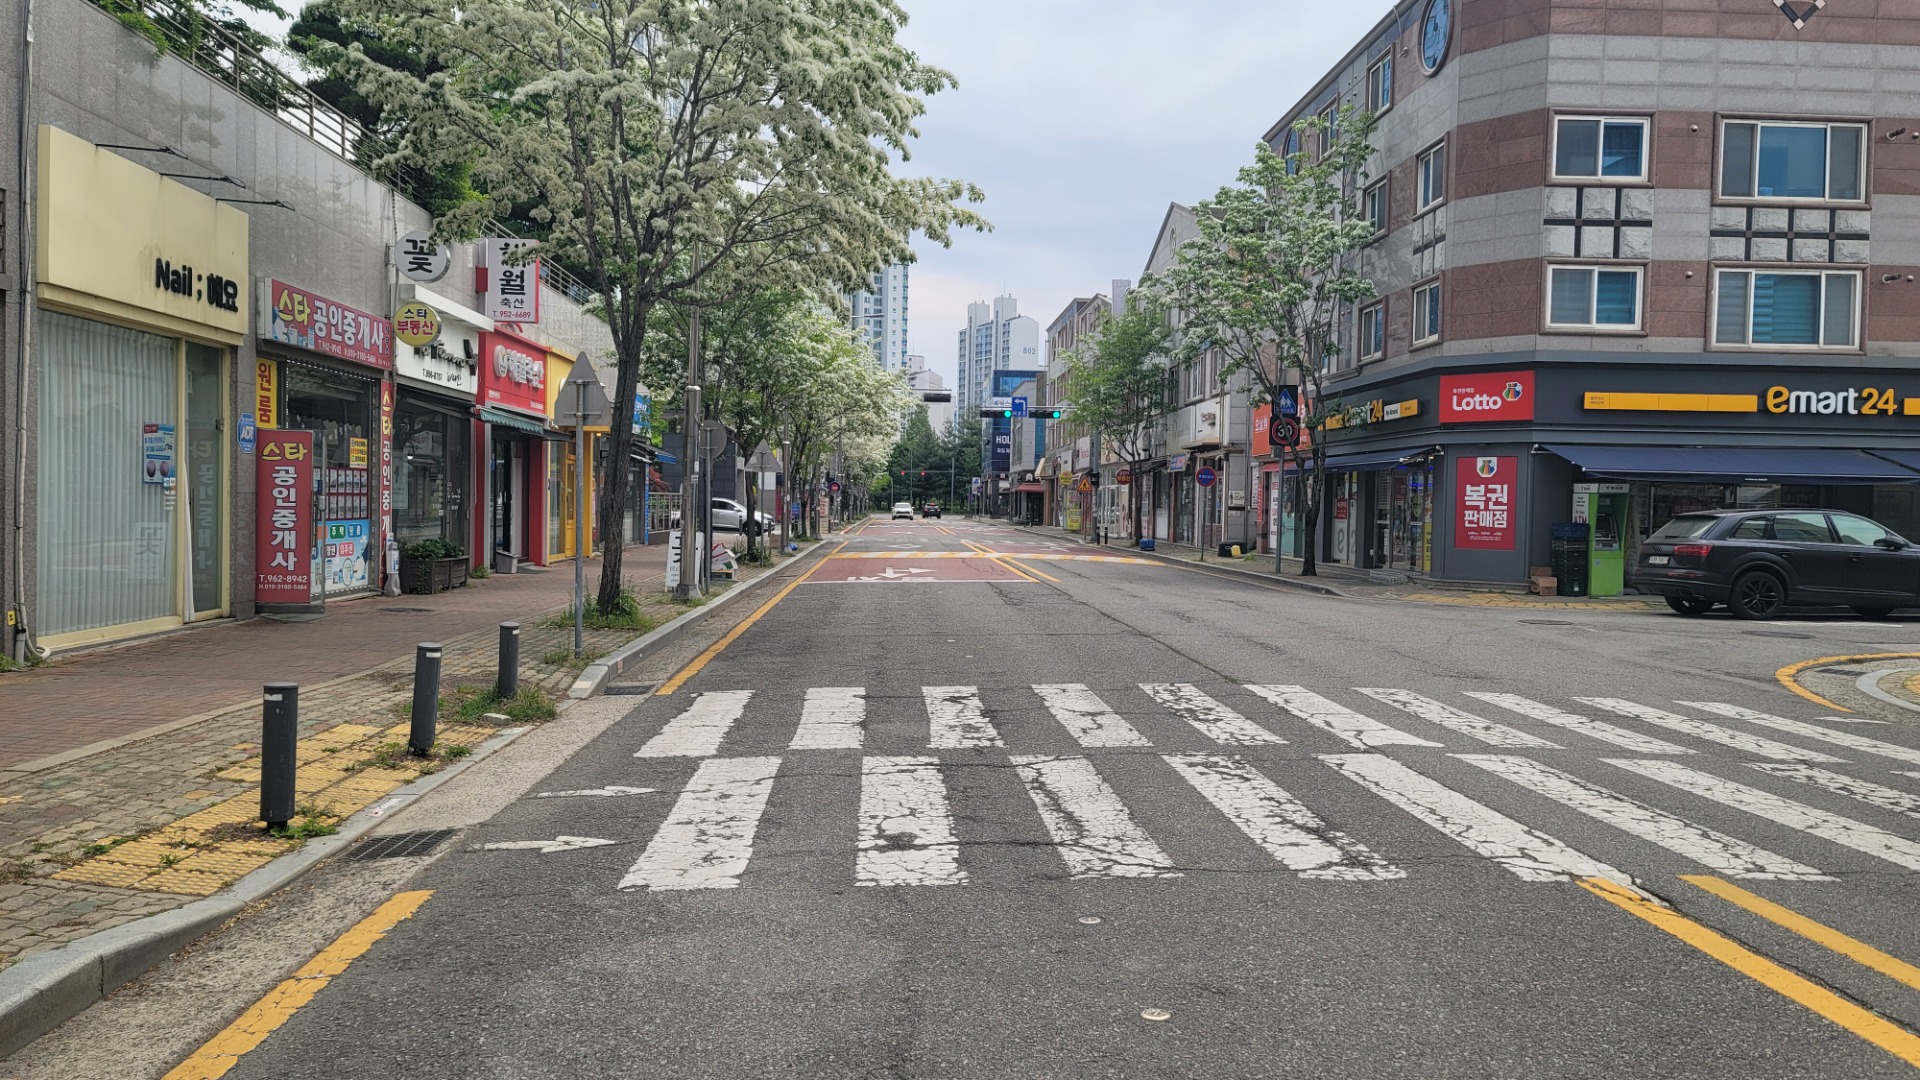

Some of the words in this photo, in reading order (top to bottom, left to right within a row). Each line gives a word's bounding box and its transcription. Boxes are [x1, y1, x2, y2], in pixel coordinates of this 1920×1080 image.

[404, 239, 438, 273] 꽃
[156, 258, 192, 297] Nail
[404, 308, 427, 319] 스타
[500, 298, 525, 309] 축산
[279, 288, 311, 326] 스타
[313, 299, 384, 354] 공인중개사
[397, 320, 434, 336] 부동산
[1022, 346, 1037, 355] 802
[258, 362, 272, 425] 원룸
[1453, 394, 1502, 411] Lotto
[1766, 385, 1898, 416] emart24
[262, 441, 309, 463] 스타
[1464, 484, 1508, 510] 복권
[270, 466, 298, 571] 공인중개사
[1464, 510, 1508, 528] 판매점
[258, 574, 308, 583] T.962-8942
